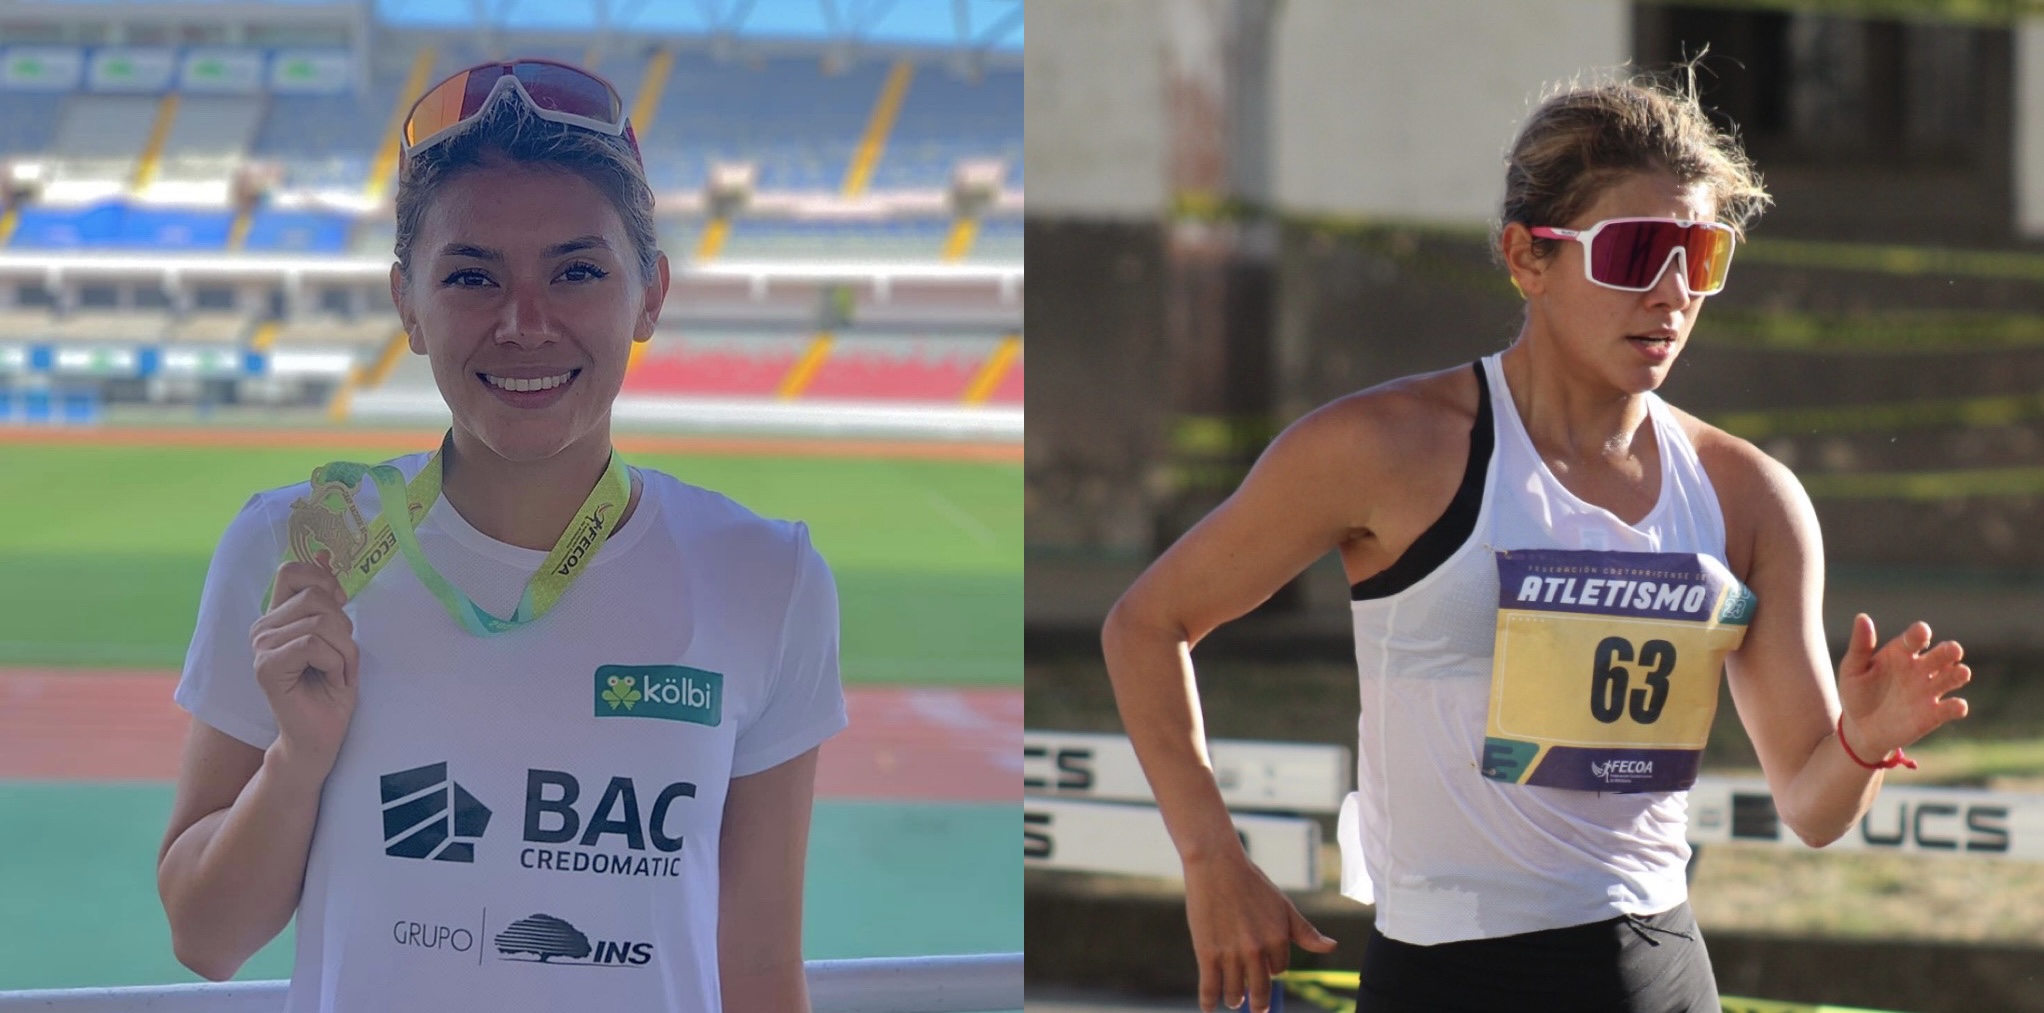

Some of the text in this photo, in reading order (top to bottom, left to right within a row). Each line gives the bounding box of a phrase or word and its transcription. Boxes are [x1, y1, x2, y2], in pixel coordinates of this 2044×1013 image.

[360, 532, 397, 574] ECOA
[558, 526, 597, 575] FECOA
[1517, 575, 1706, 613] ATLETISMO
[1722, 598, 1746, 619] 23
[644, 675, 711, 709] kölbi
[1590, 636, 1677, 724] 63
[1611, 760, 1653, 774] FECOA
[523, 769, 697, 853] BAC
[1861, 803, 2009, 852] UCS
[520, 848, 681, 877] CREDOMATIC
[393, 920, 654, 965] GRUPO INS
